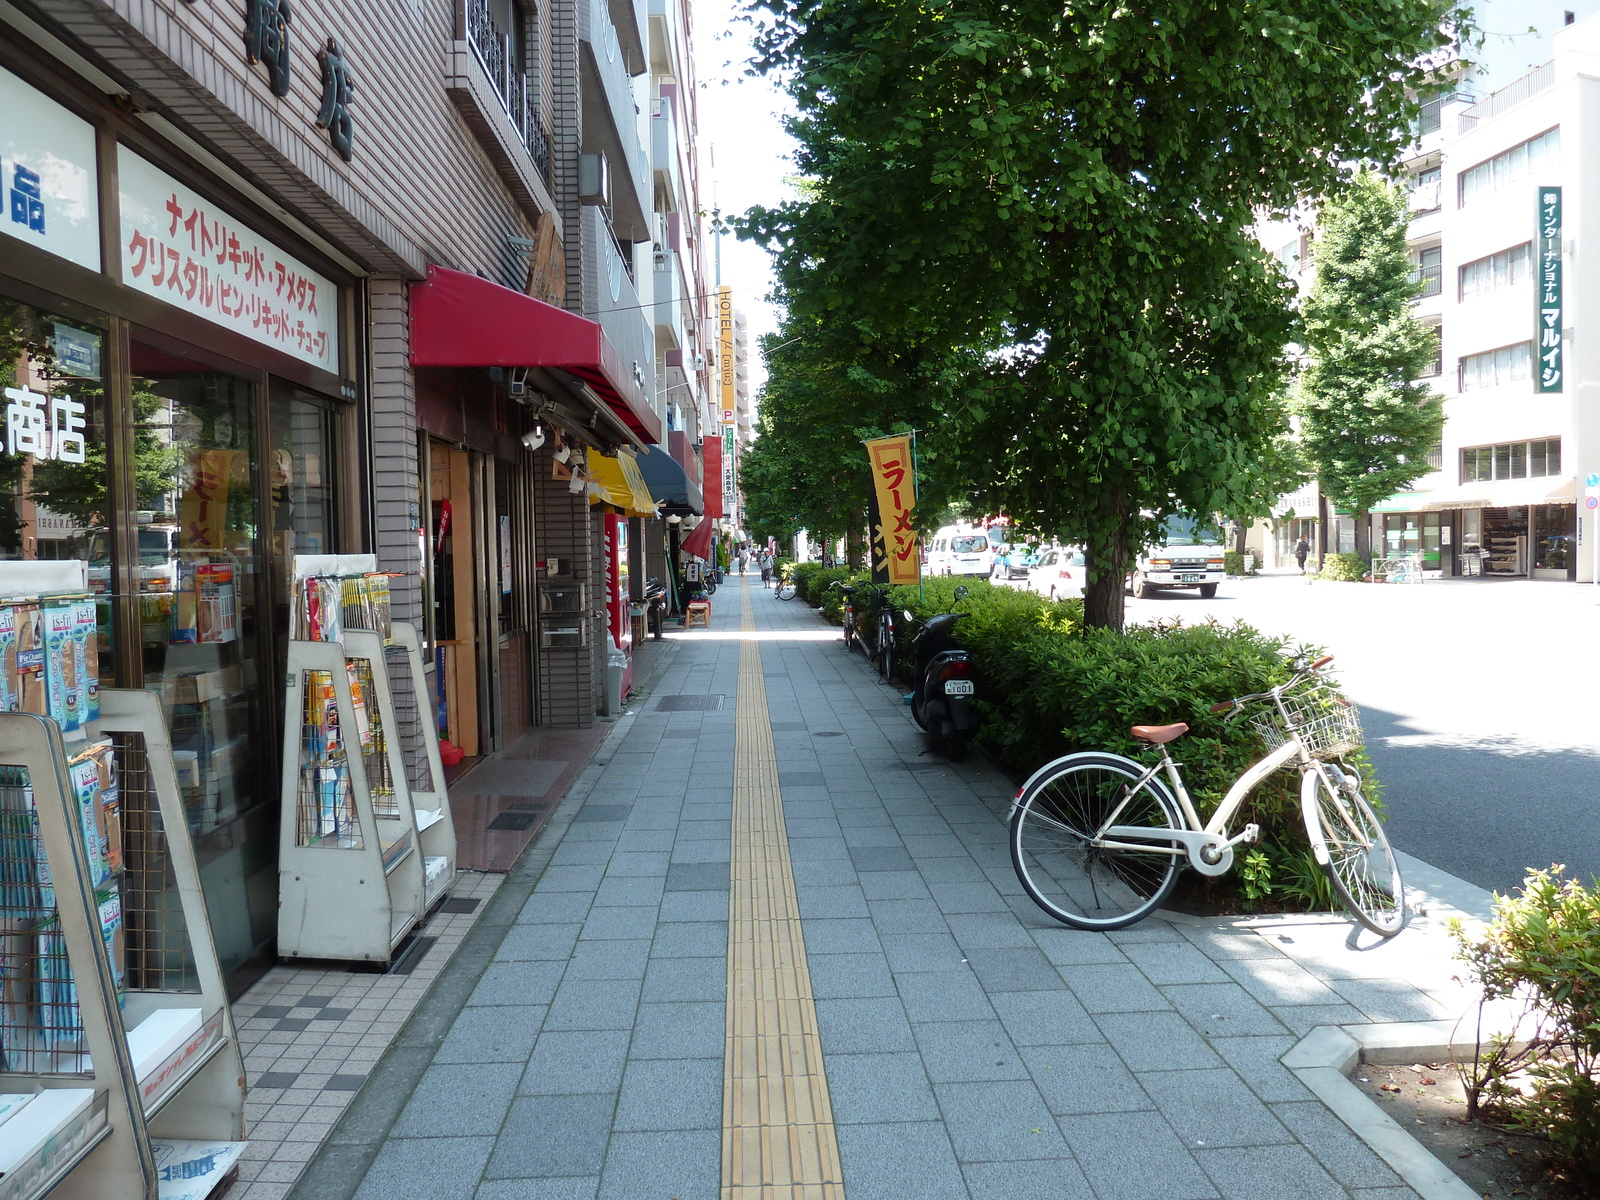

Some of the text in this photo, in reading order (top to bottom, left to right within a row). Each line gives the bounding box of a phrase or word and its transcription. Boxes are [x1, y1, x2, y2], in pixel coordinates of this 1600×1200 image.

[0, 156, 46, 236] 品
[166, 193, 318, 315] ナイトリキッド・アメダス
[721, 291, 732, 335] HOTEL
[1541, 308, 1560, 387] マルイシ
[0, 384, 86, 464] 商店
[724, 410, 733, 420] P
[882, 460, 914, 562] ラーメン
